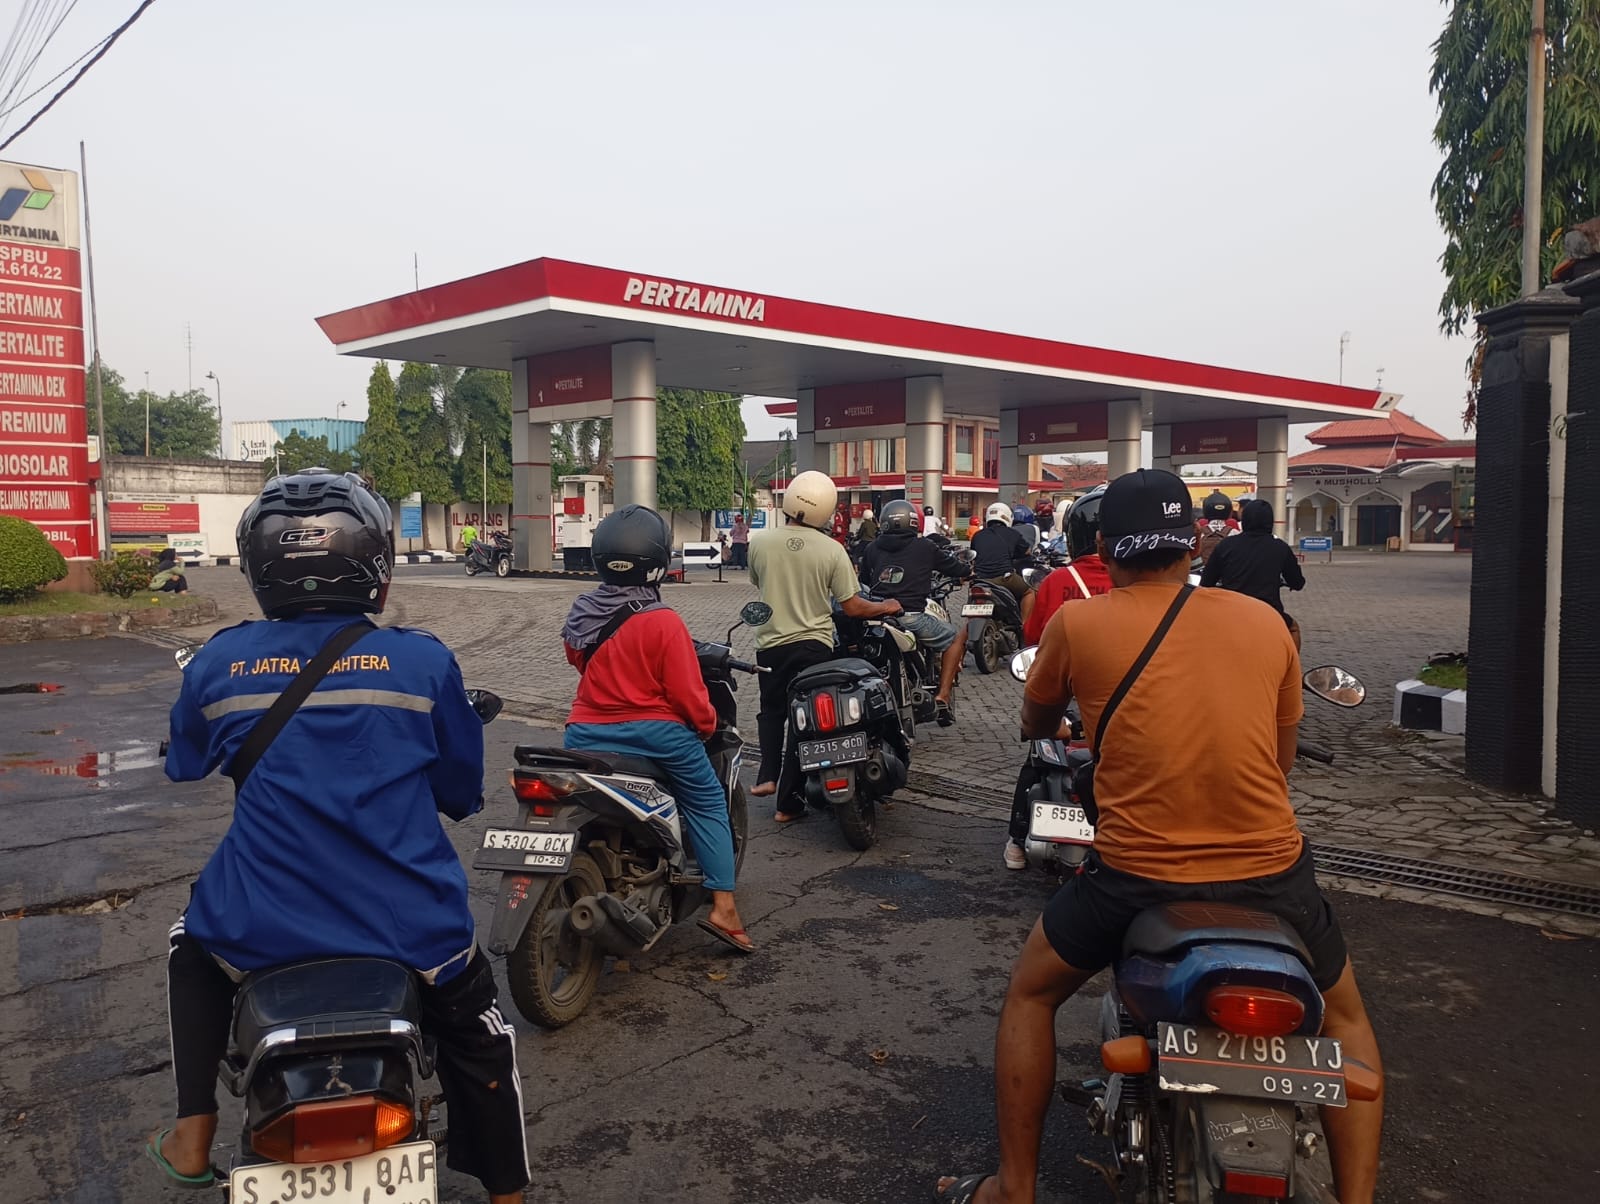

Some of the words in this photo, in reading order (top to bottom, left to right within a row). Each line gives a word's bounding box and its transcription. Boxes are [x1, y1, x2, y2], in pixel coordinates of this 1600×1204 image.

[0, 224, 60, 242] RTAMINA
[0, 245, 48, 265] SPBU
[0, 260, 63, 281] 4.614.22
[0, 291, 64, 320] ERTAMAX
[623, 277, 766, 322] PERTAMINA
[0, 331, 65, 358] ERTALITE
[46, 375, 66, 398] DEX
[0, 410, 67, 435] REMIUM
[824, 416, 832, 428] 2
[1029, 432, 1036, 442] 3
[0, 490, 29, 510] ELUMAS
[30, 490, 71, 510] PERTAMINA
[1162, 502, 1182, 515] Lee
[452, 512, 503, 527] ILARNG
[43, 530, 71, 541] OBIL
[1114, 532, 1197, 558] Original
[230, 660, 249, 678] PT.
[252, 657, 301, 674] JATRA
[306, 655, 390, 675] AHTERA
[803, 746, 809, 756] S
[814, 741, 838, 755] 2515
[1035, 806, 1043, 818] S
[1052, 807, 1085, 822] 6599
[488, 833, 497, 849] S
[502, 834, 539, 851] 5304
[1164, 1025, 1198, 1055] AG
[1217, 1033, 1287, 1064] 2796
[1304, 1039, 1343, 1070] YJ
[243, 1176, 259, 1204] S
[281, 1160, 352, 1202] 3531
